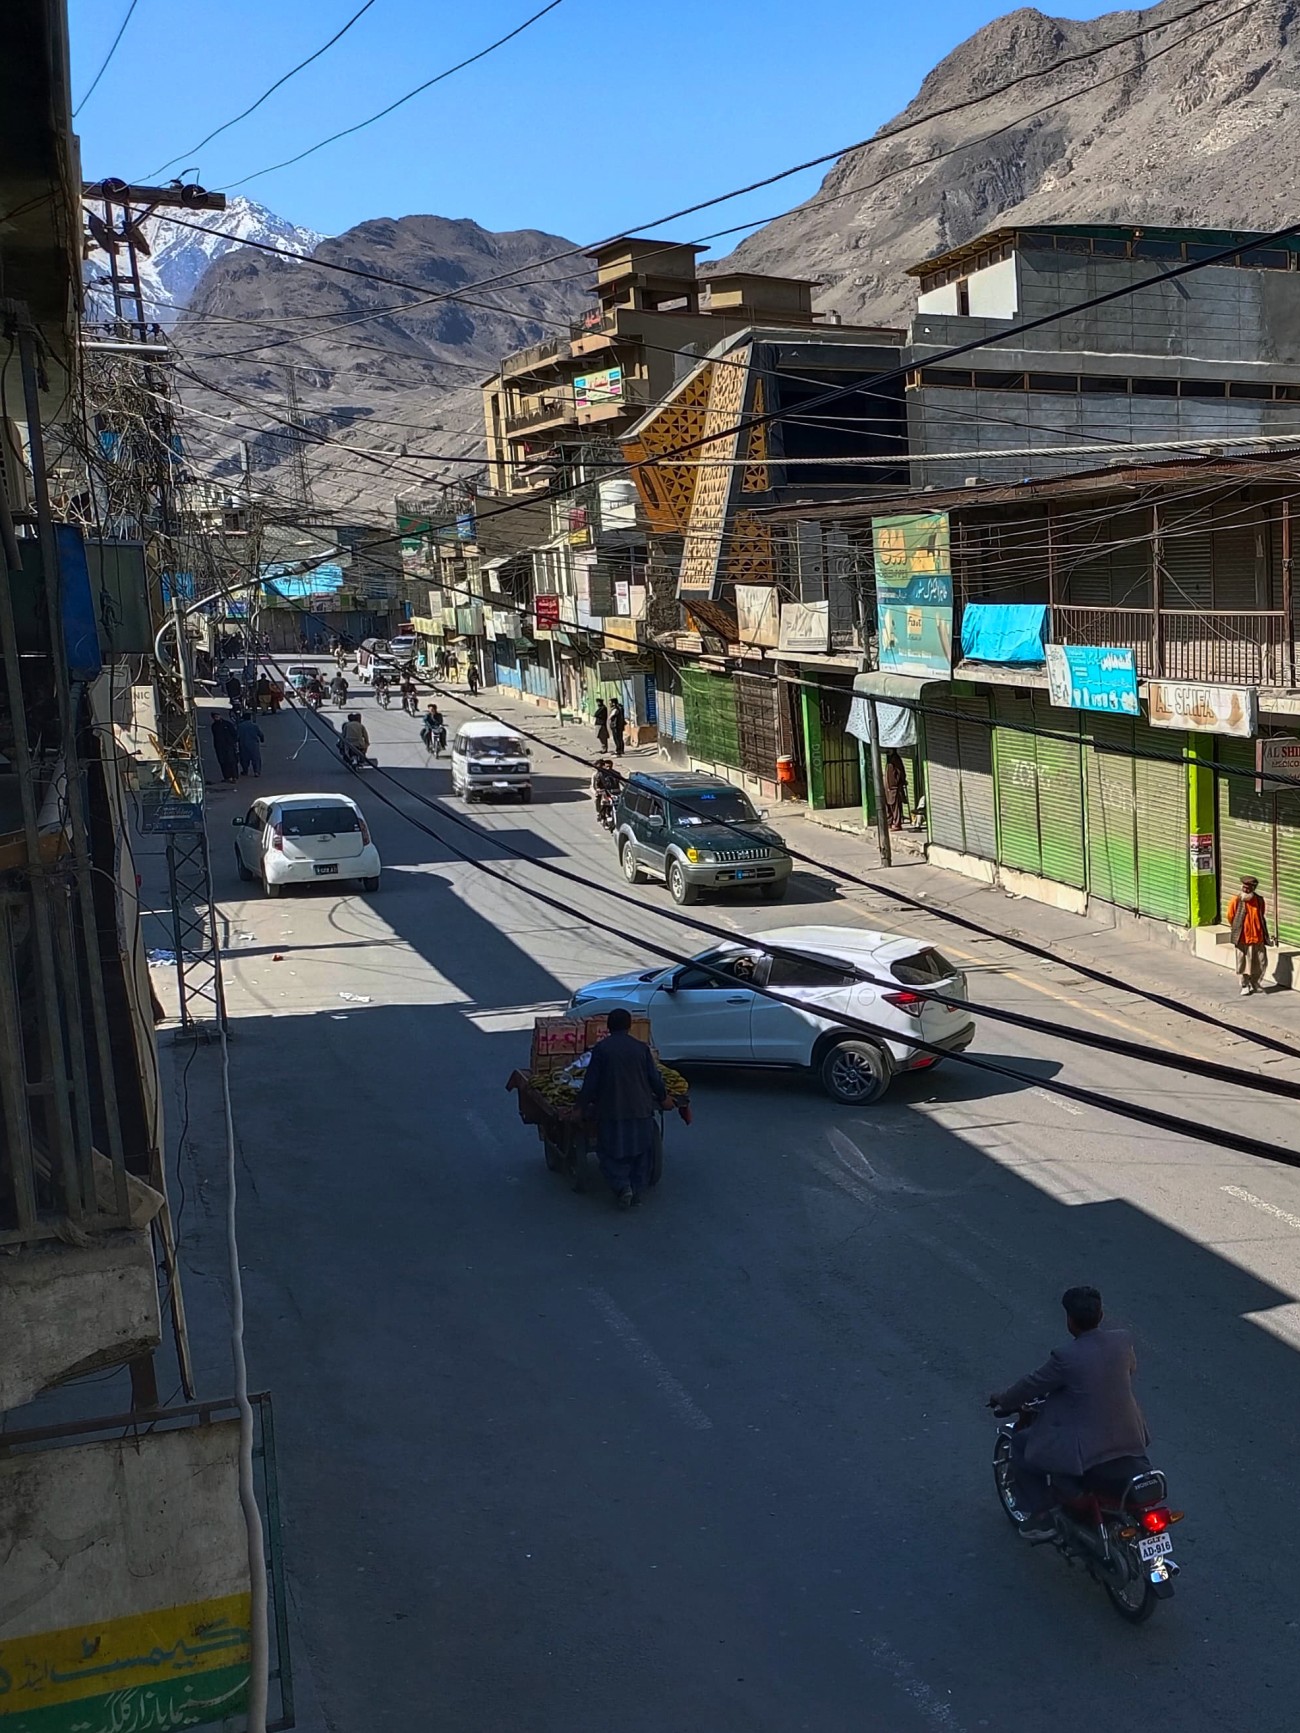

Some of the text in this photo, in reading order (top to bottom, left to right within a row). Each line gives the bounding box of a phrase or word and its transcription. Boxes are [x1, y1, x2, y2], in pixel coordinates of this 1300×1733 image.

[1156, 686, 1214, 718] AL SHIFA
[1267, 746, 1280, 758] AL
